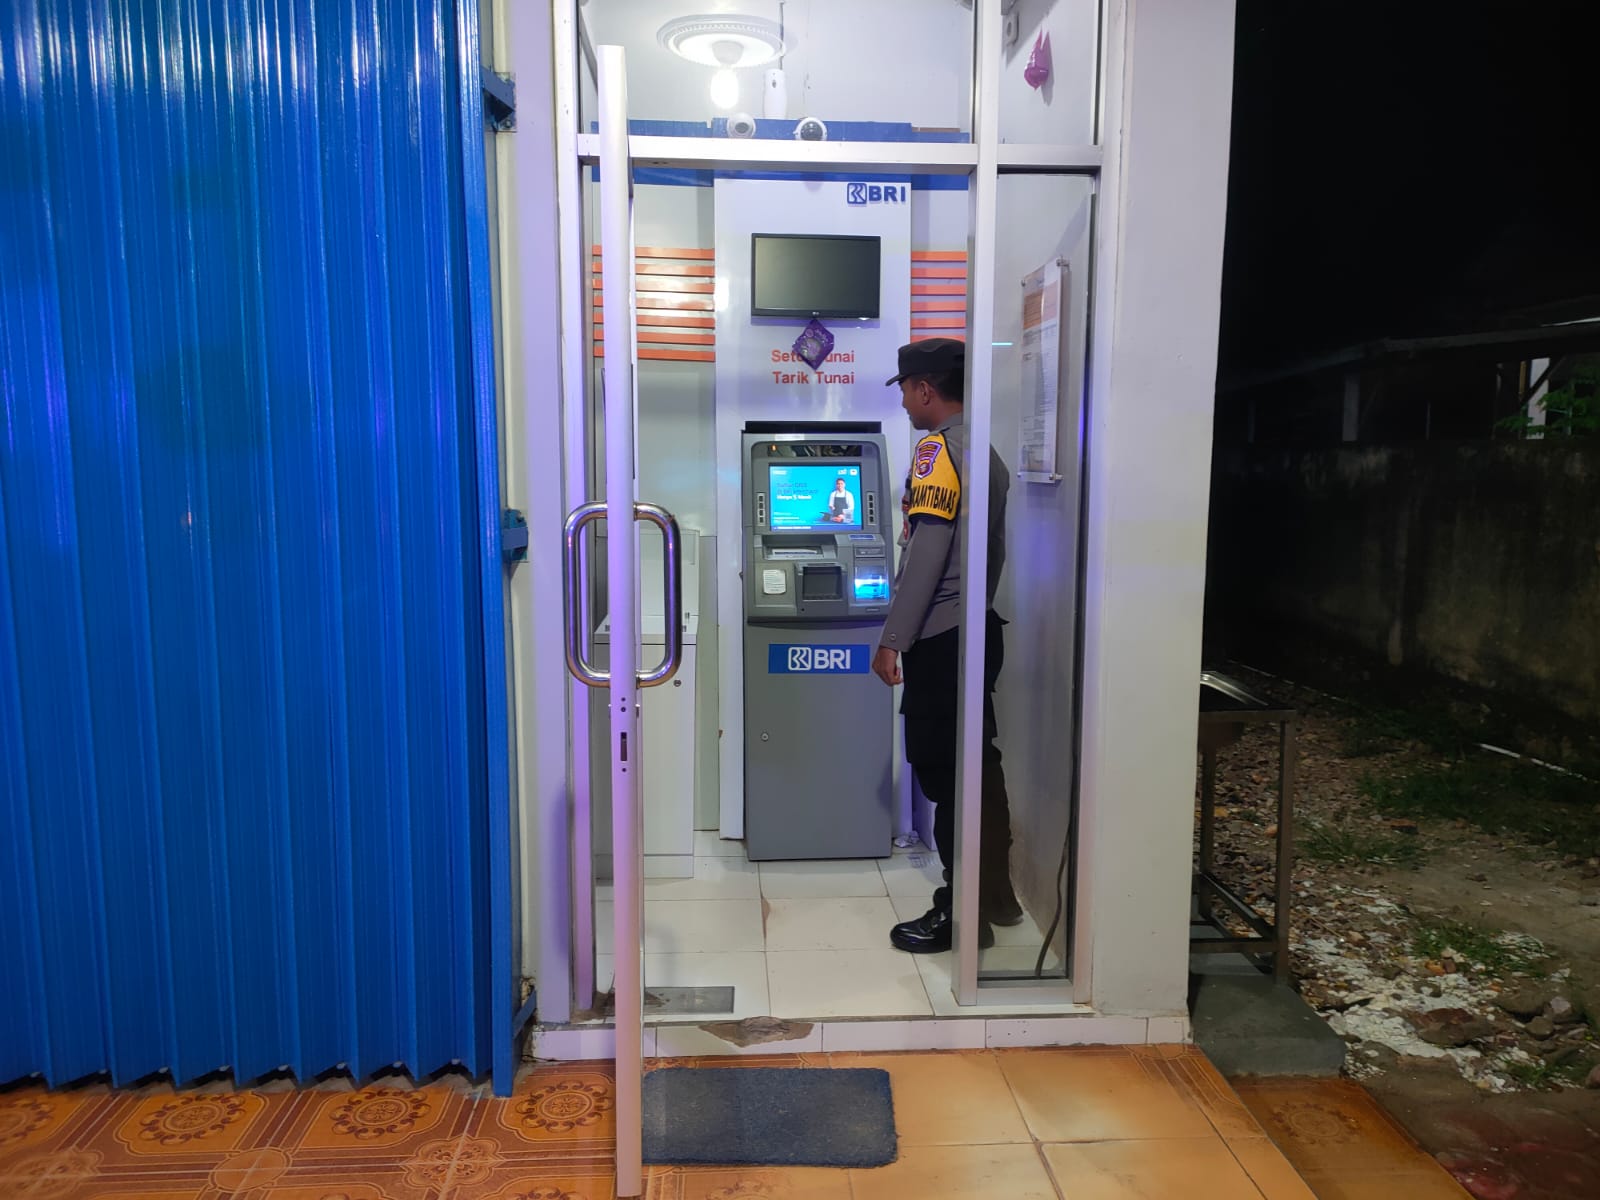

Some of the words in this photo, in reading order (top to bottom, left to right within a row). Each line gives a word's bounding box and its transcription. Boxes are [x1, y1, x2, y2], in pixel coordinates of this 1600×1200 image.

[868, 185, 906, 202] BRI
[824, 350, 855, 363] unai
[772, 371, 809, 384] Tarik
[815, 371, 855, 384] Tunai
[813, 648, 851, 670] BRI
